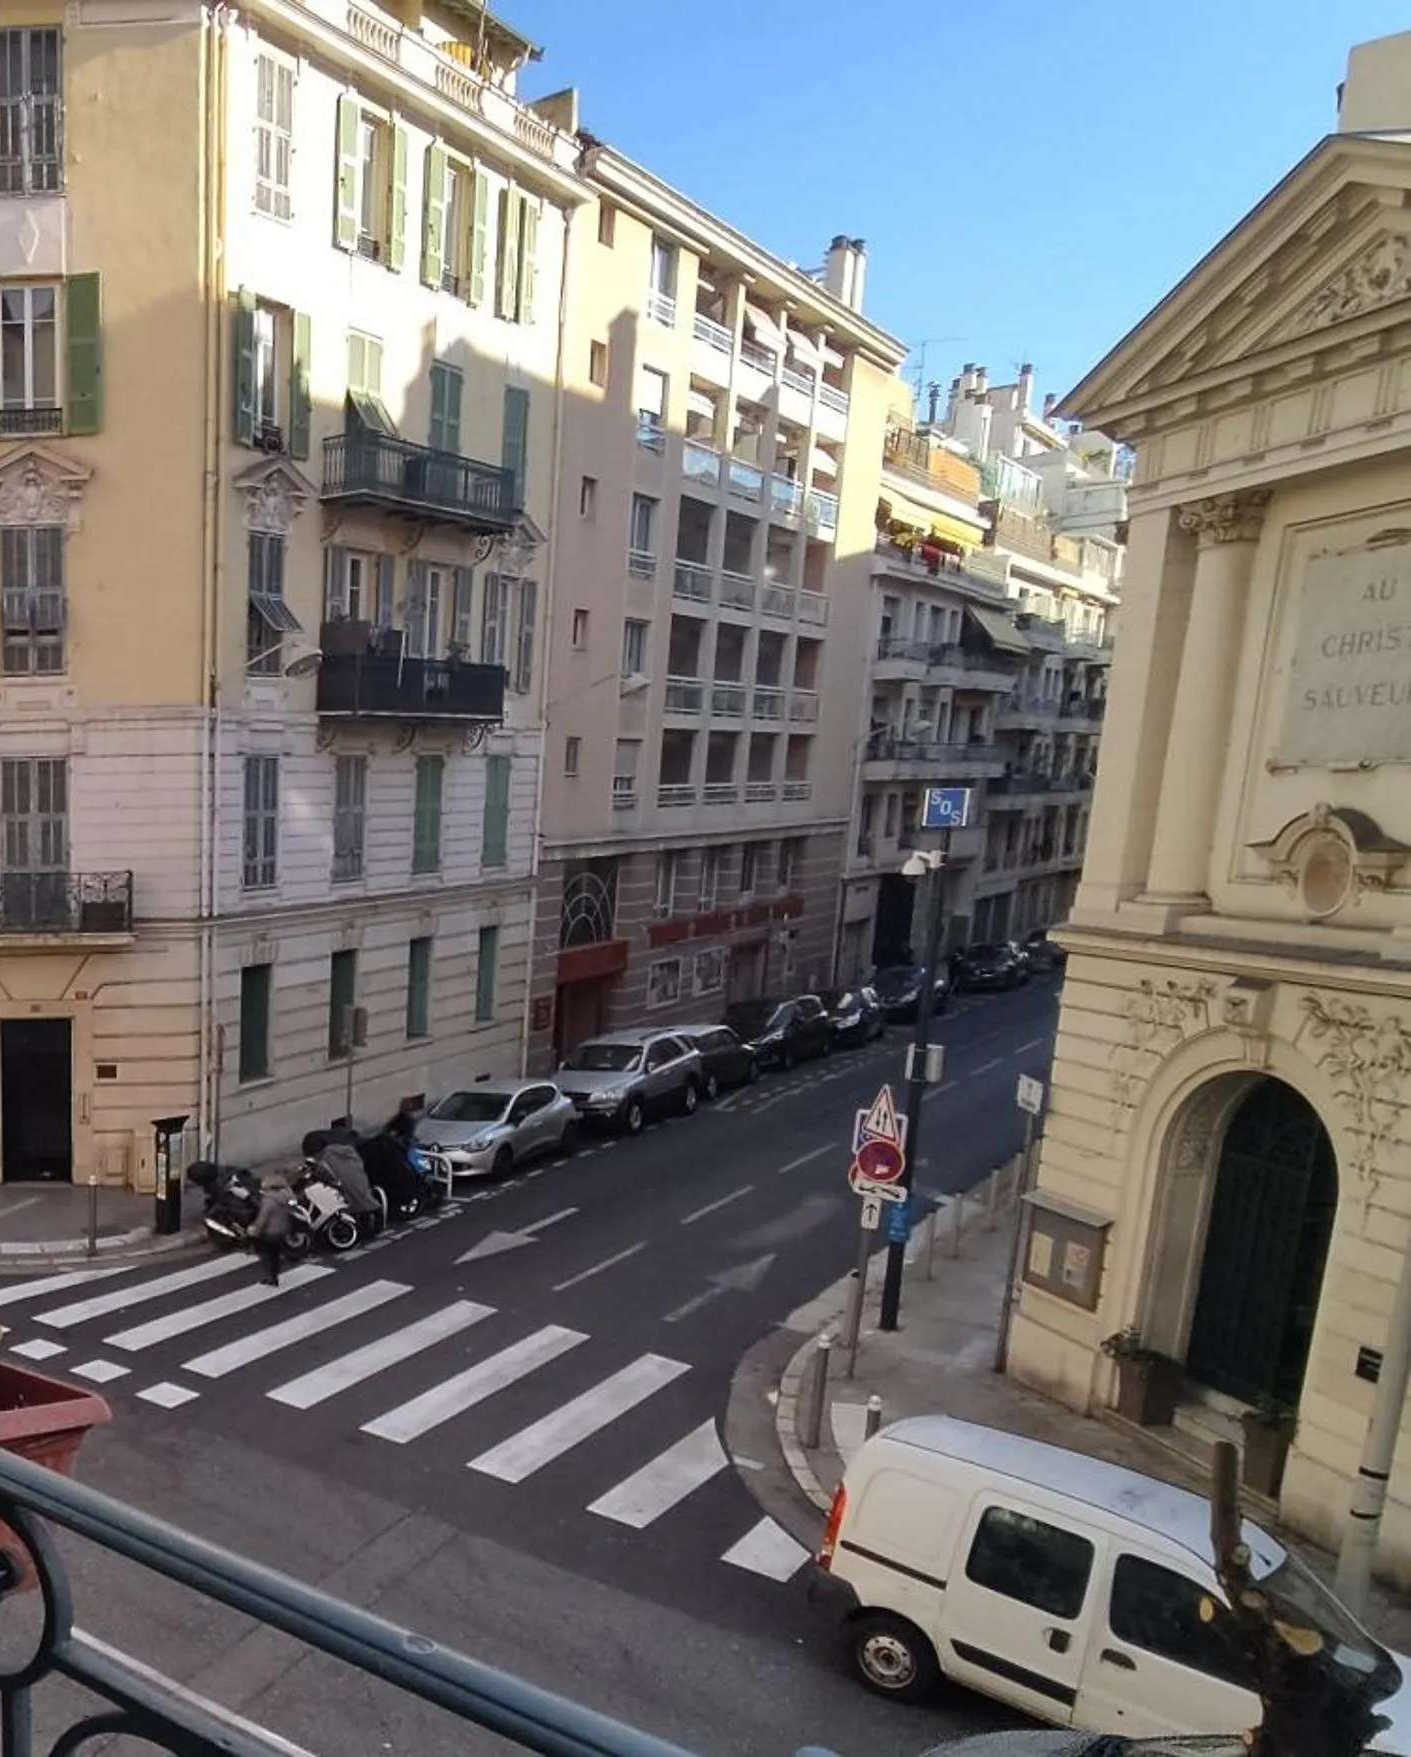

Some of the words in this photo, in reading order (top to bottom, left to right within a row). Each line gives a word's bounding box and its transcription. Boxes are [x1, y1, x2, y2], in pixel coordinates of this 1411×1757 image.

[1361, 577, 1398, 602] AU
[1320, 622, 1411, 659] CHRIS
[1303, 681, 1411, 711] SAUVEU
[930, 790, 962, 825] SOS
